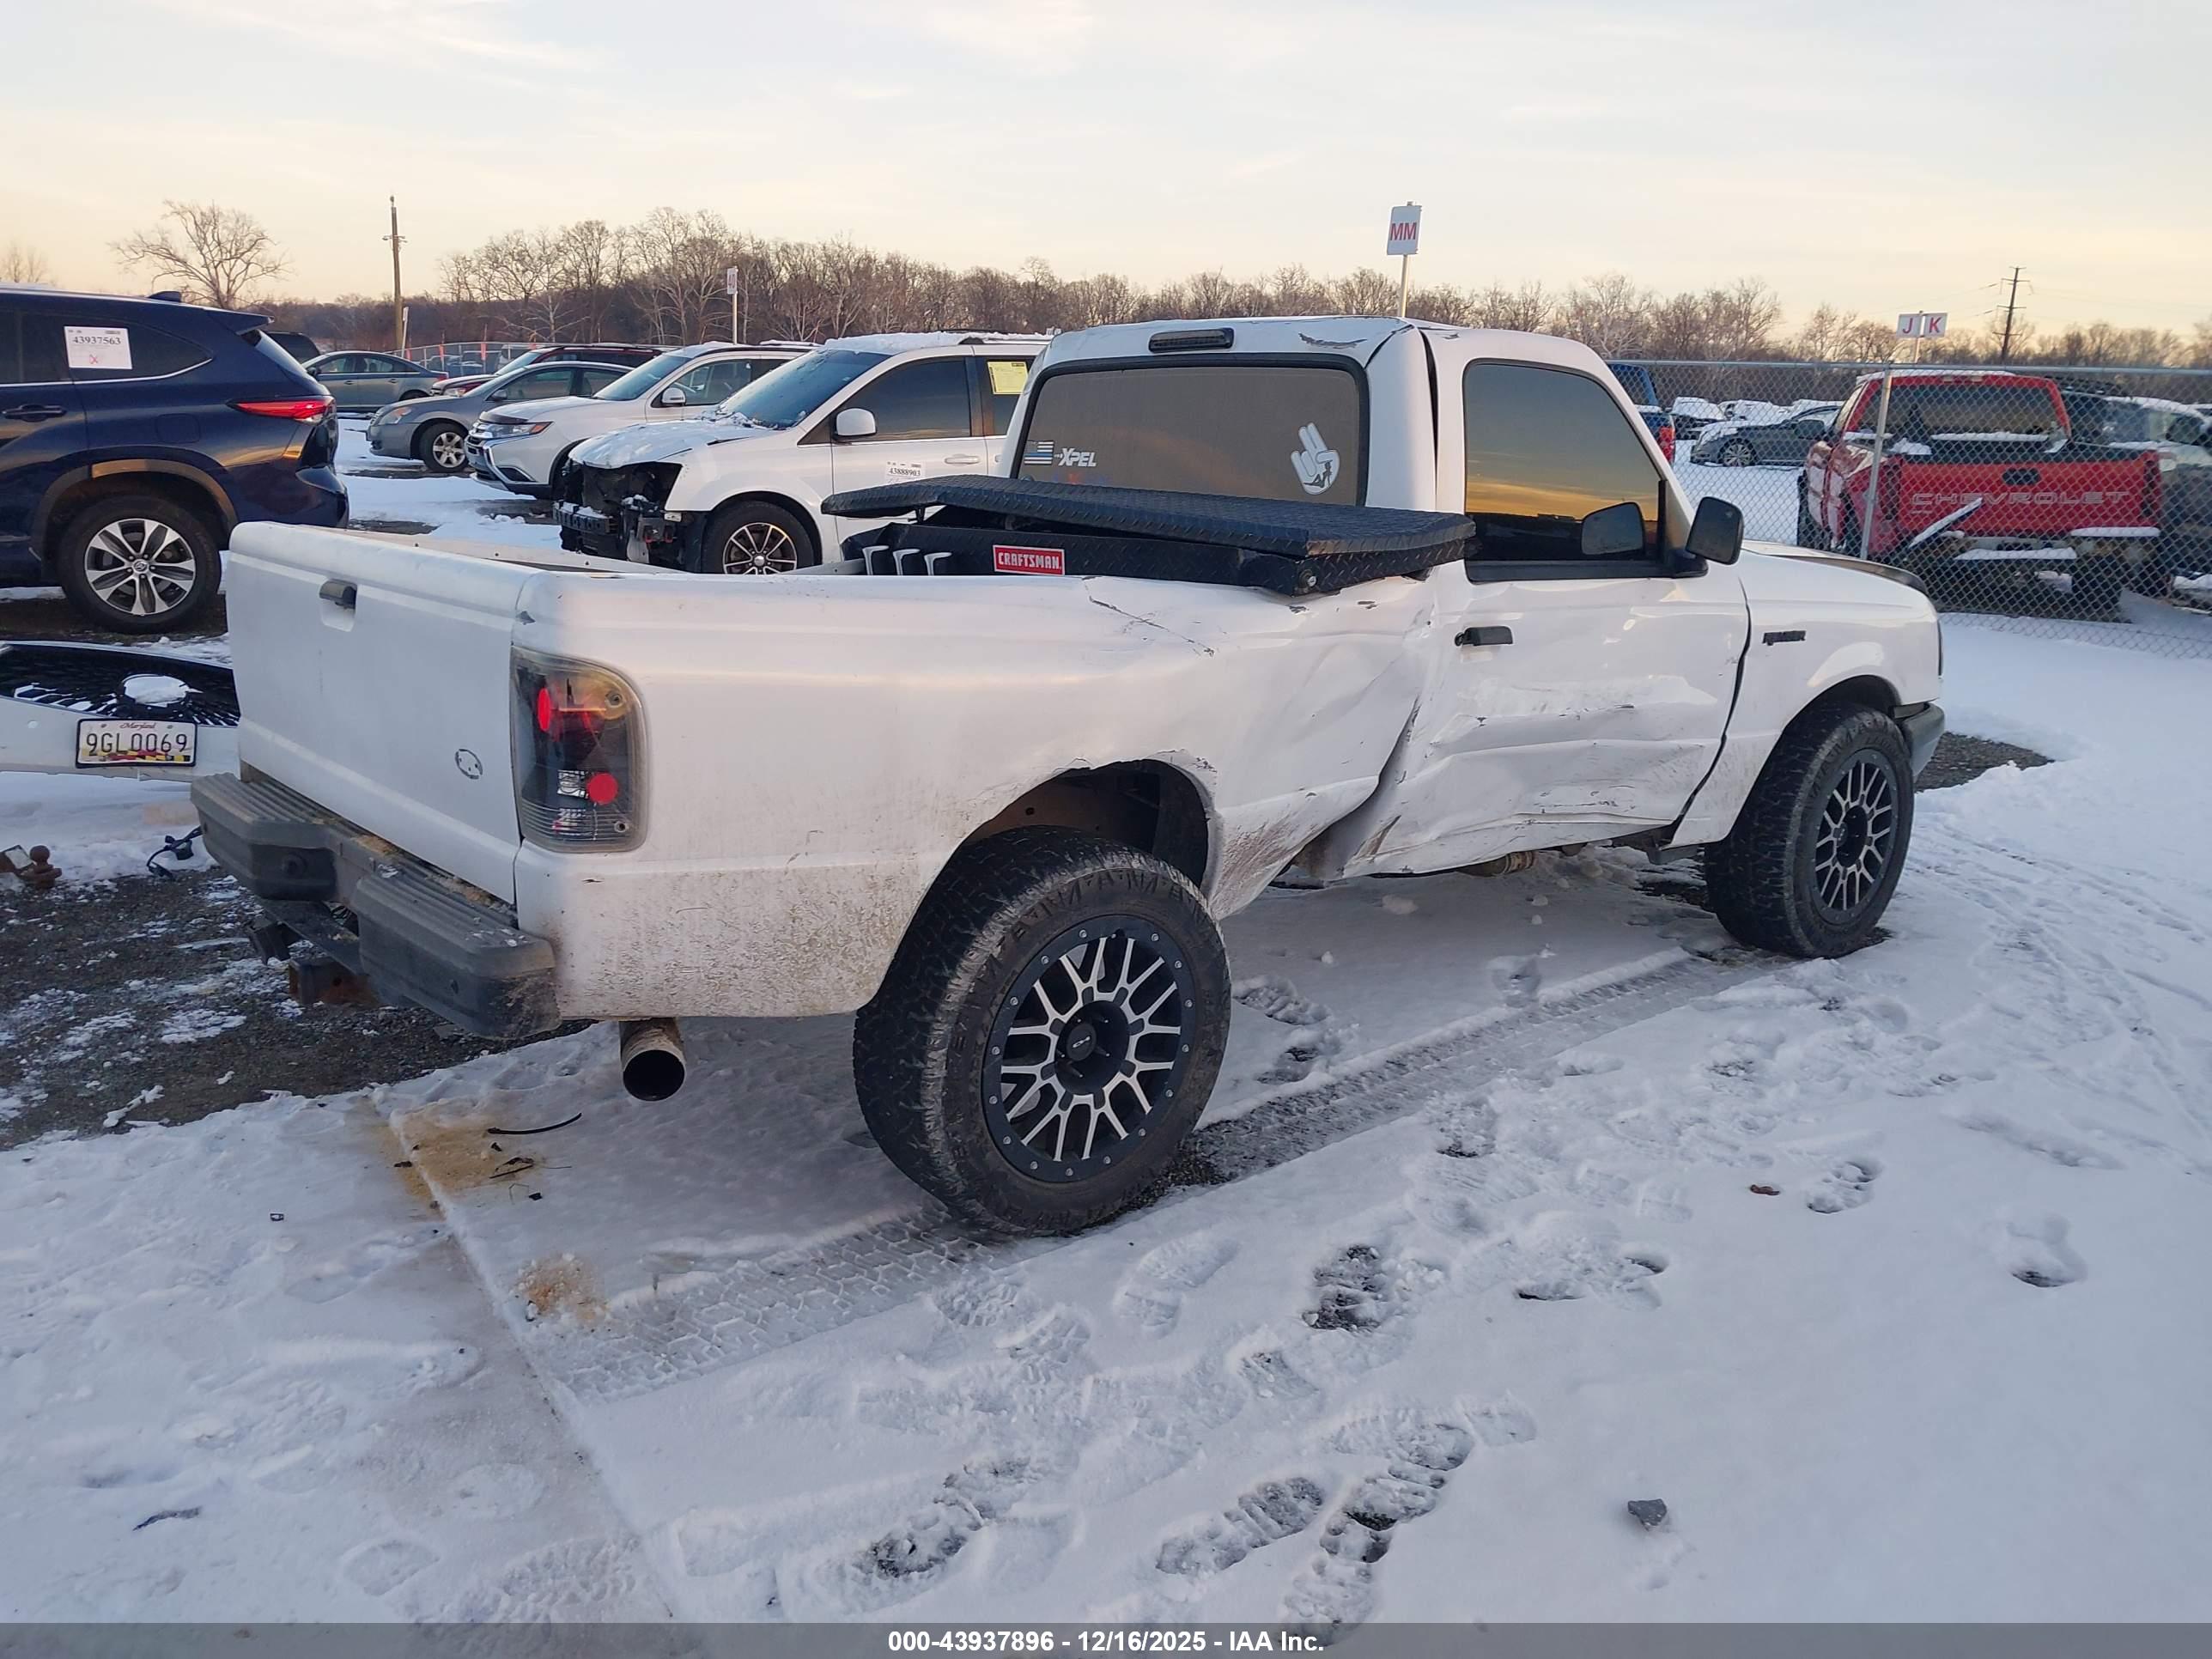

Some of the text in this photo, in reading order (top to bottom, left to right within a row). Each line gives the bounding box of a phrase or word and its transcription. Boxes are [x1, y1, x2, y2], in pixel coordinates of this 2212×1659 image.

[1390, 222, 1417, 240] MM
[1902, 317, 1913, 334] J
[1929, 316, 1942, 333] K
[72, 335, 121, 345] 43937563
[1058, 447, 1097, 467] XPEL
[1911, 491, 2130, 507] CHEVROLET
[998, 551, 1060, 569] CRAFTSMAN
